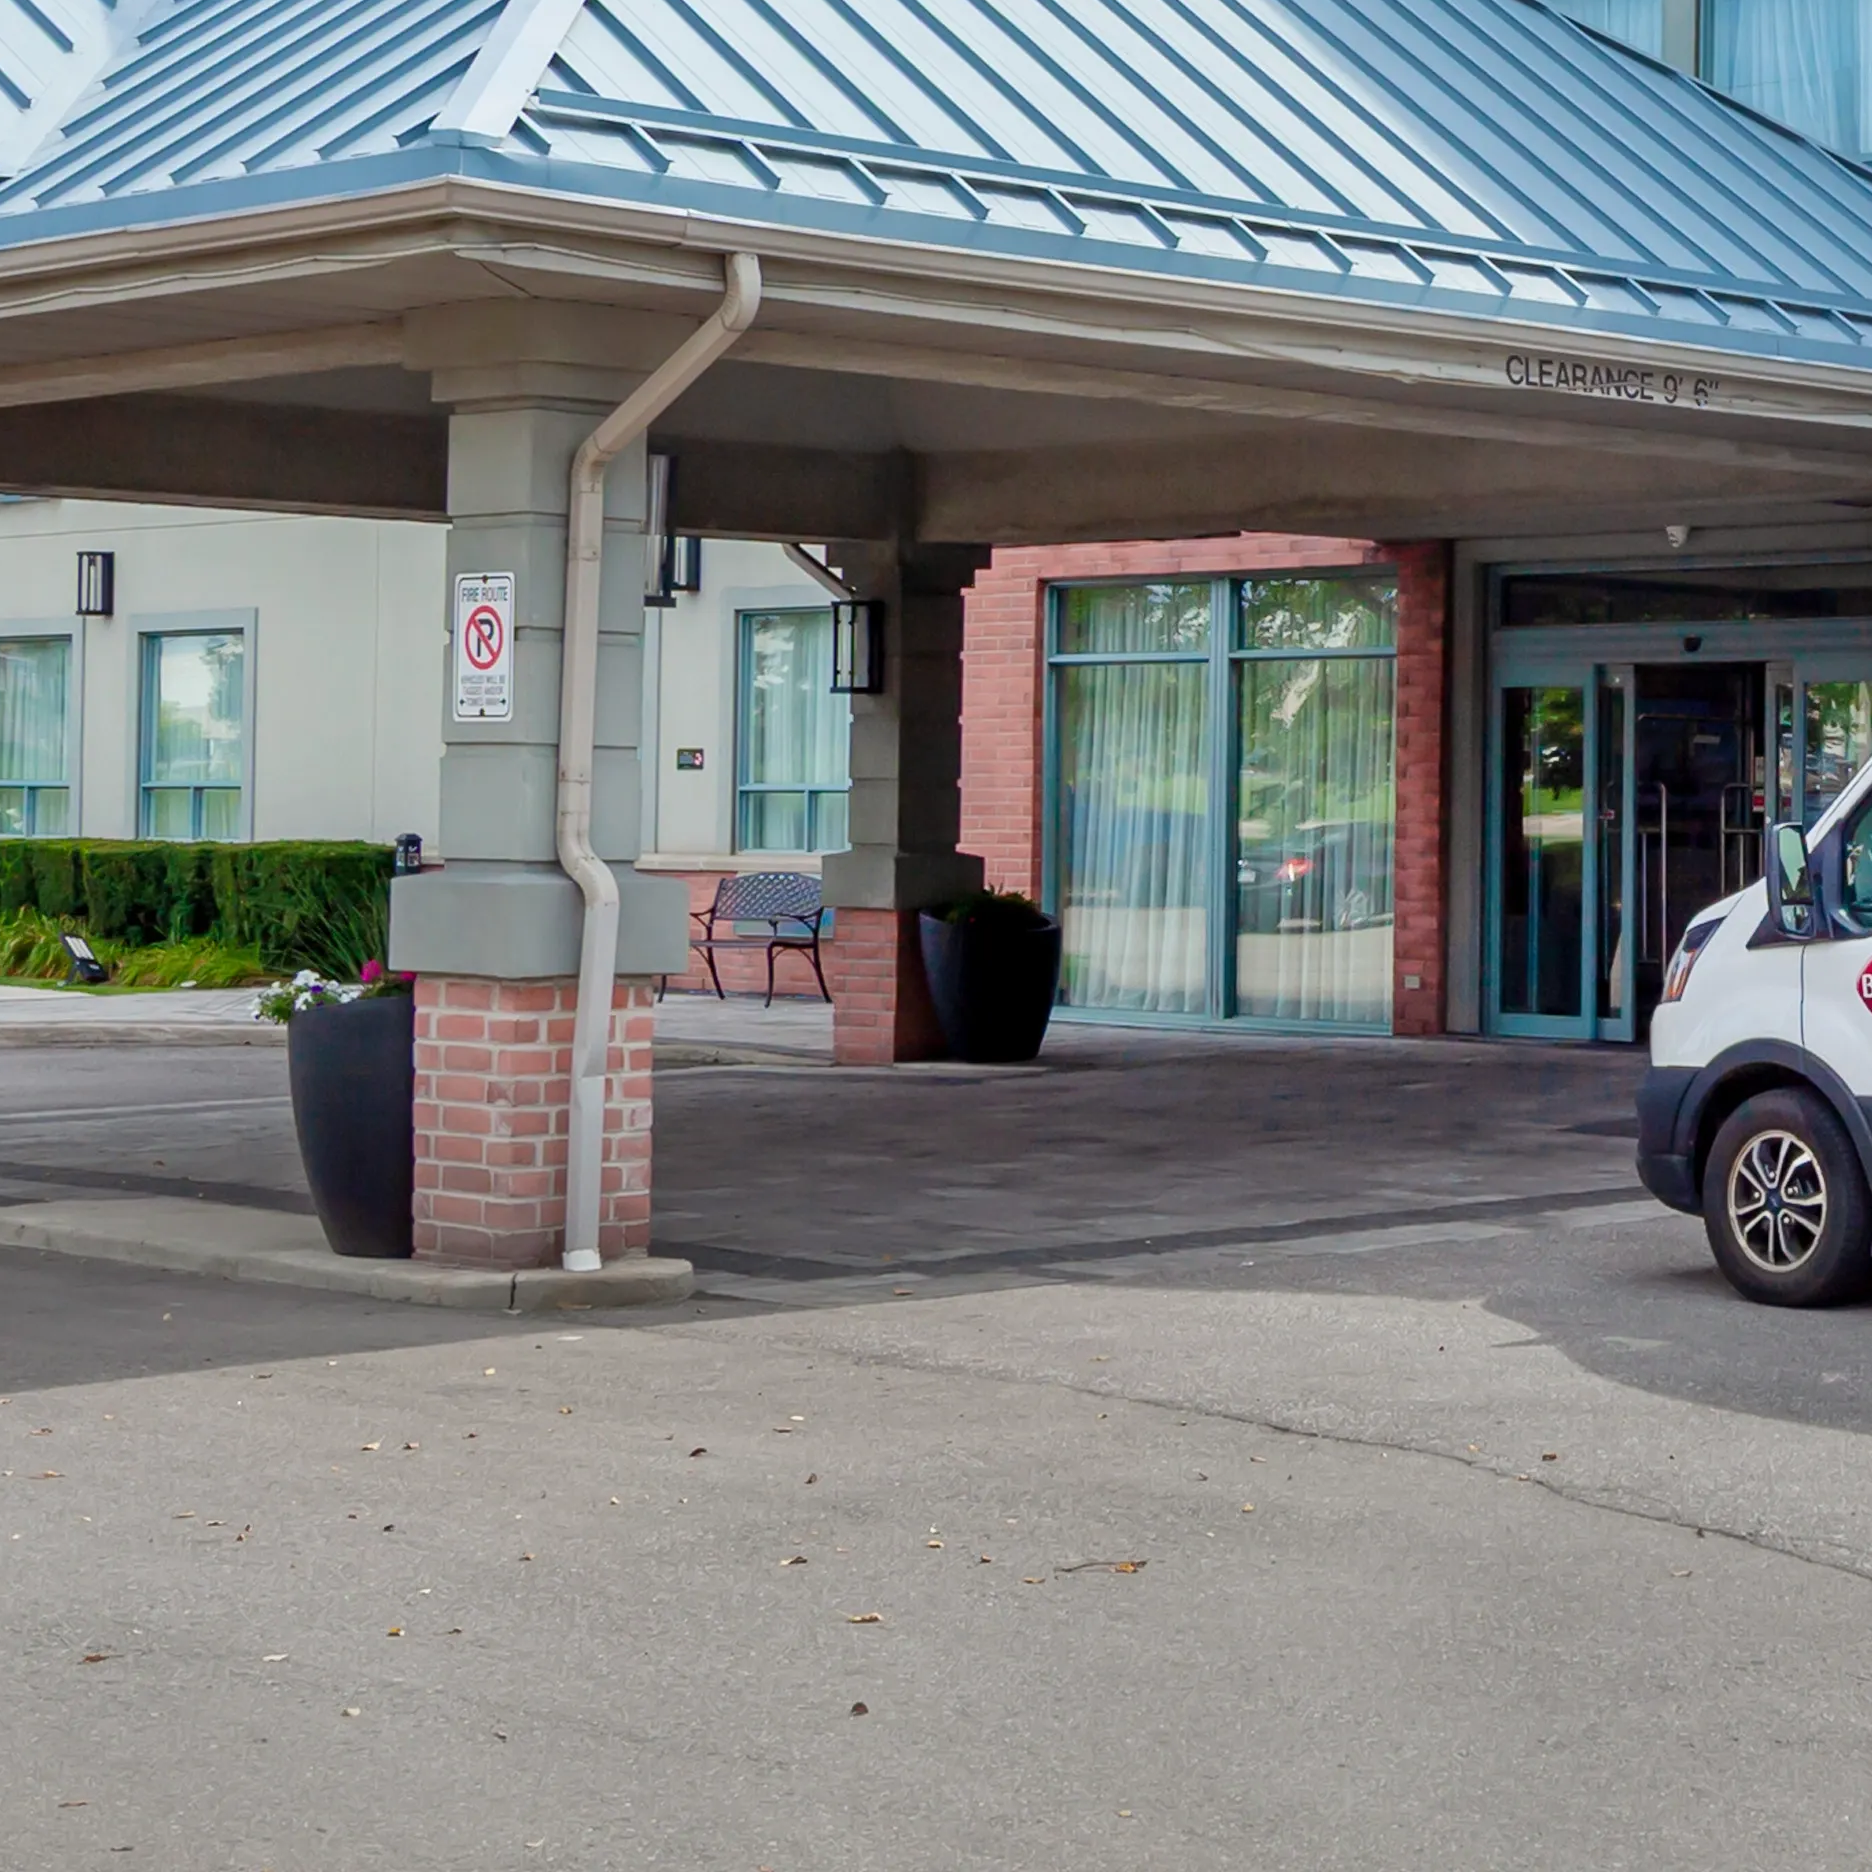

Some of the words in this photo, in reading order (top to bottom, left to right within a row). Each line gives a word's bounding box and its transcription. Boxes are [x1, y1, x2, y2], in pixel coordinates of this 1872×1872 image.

[1505, 354, 1655, 402] CLEARANCE
[461, 587, 479, 603] FIRE
[481, 586, 508, 602] ROUTE
